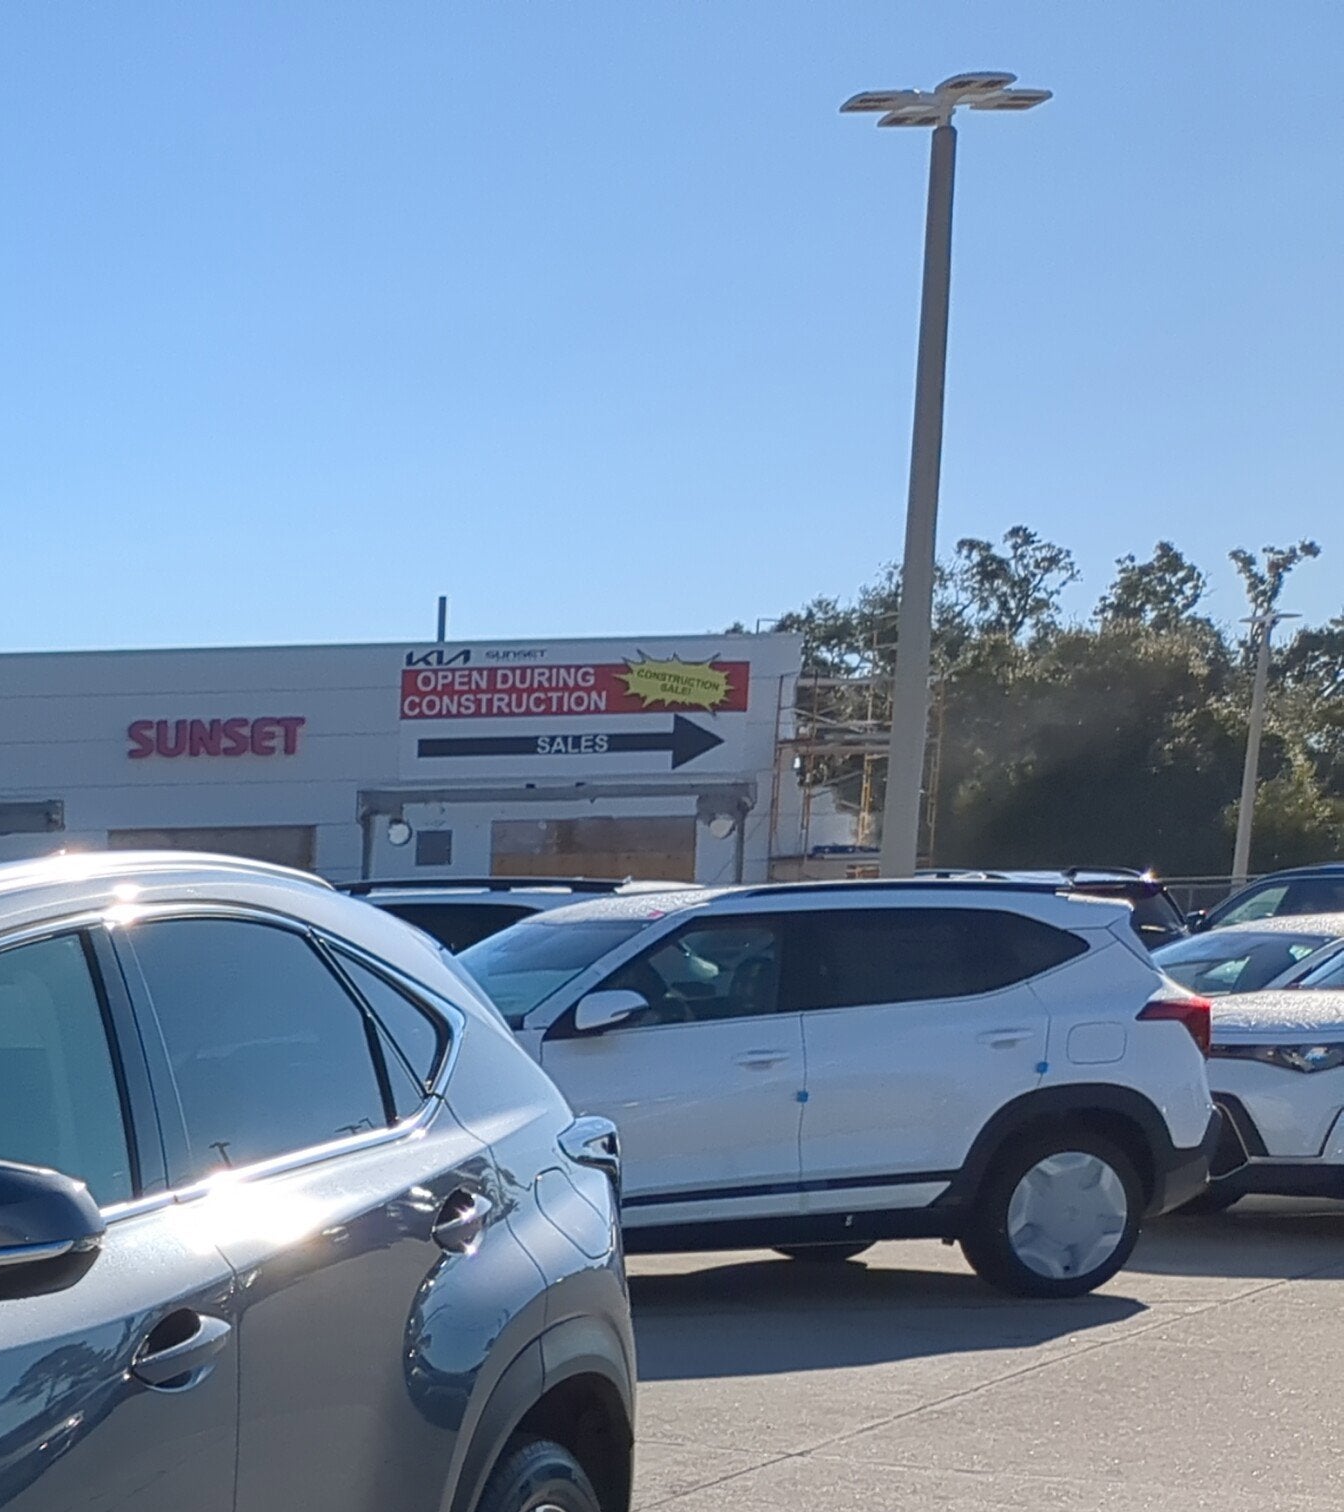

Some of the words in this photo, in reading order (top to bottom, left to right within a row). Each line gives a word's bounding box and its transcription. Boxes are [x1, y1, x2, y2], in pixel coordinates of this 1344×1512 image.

[406, 650, 471, 667] KIA
[417, 670, 488, 692] OPEN
[496, 667, 596, 690] DURING
[637, 669, 720, 691] CONSTRUCTION
[403, 690, 607, 717] CONSTRUCTION
[127, 716, 306, 759] SUNSET
[537, 734, 608, 755] SALES
